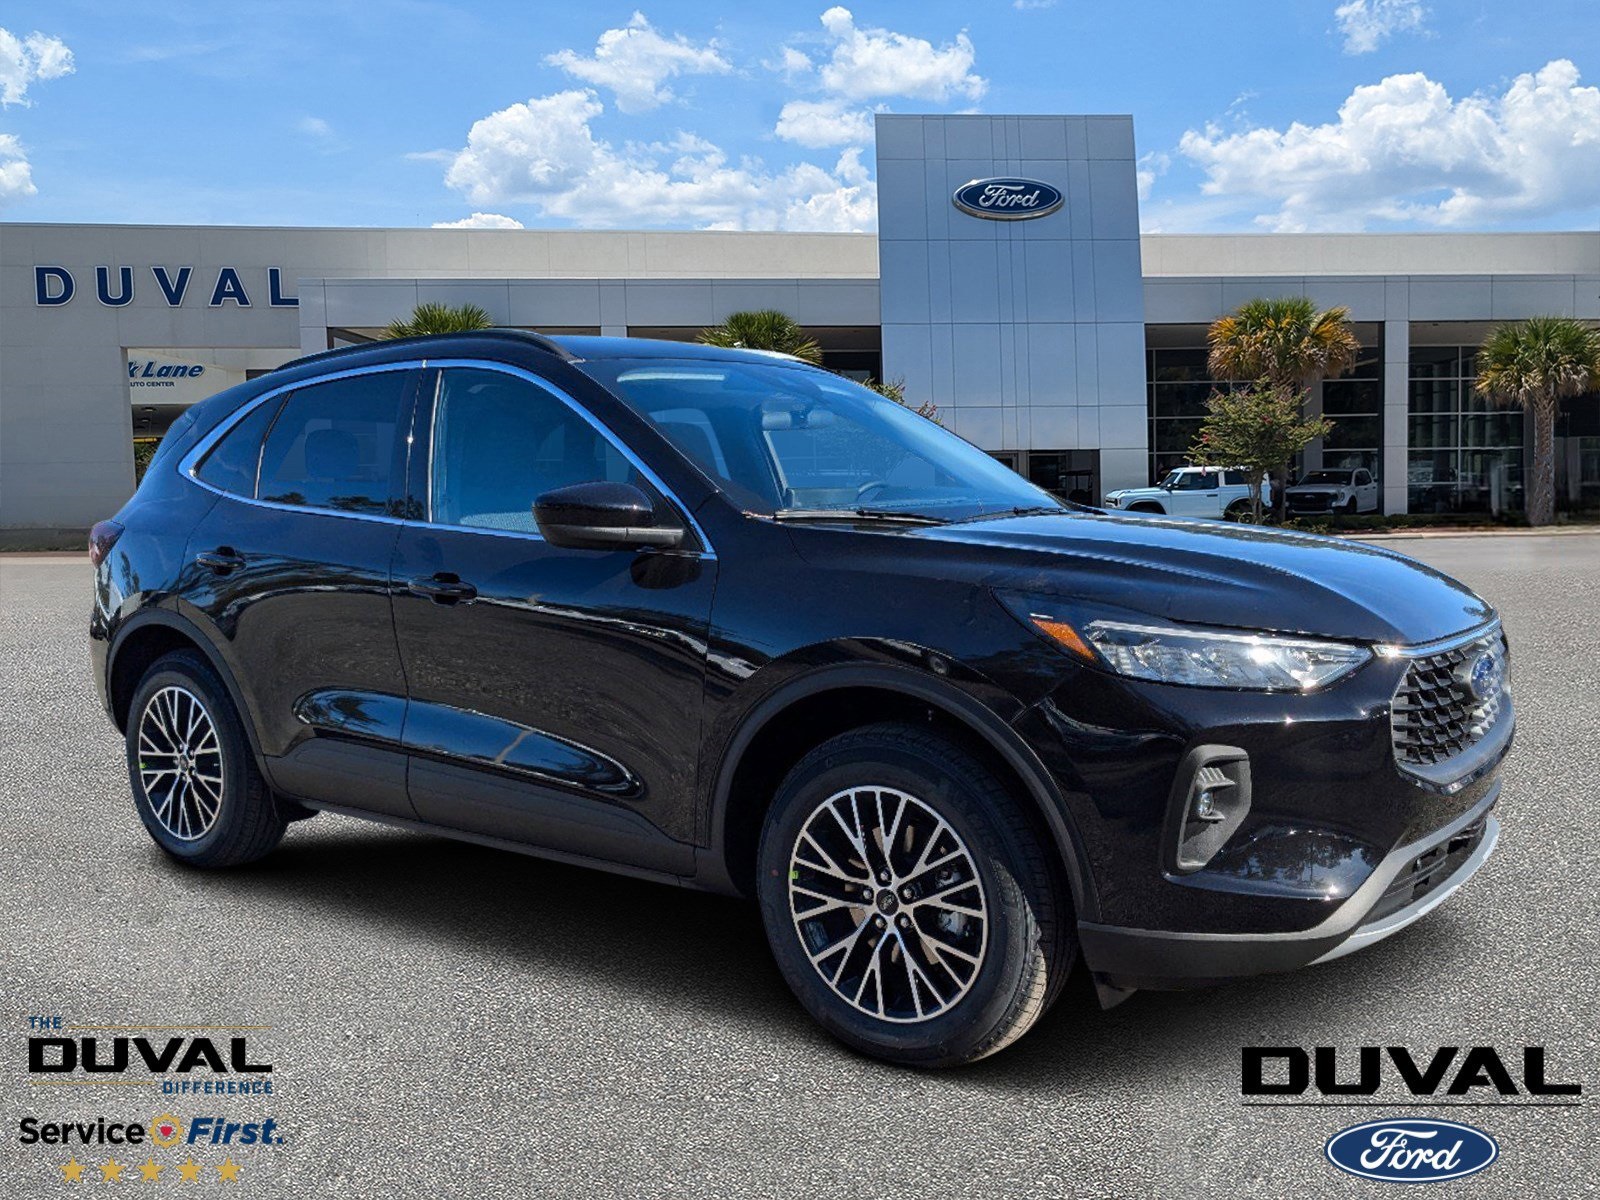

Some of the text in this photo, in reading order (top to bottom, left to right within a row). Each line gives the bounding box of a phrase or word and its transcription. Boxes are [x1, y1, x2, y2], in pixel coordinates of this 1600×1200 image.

[979, 185, 1040, 207] Ford
[34, 265, 299, 307] DUVAL
[142, 361, 205, 378] Lane
